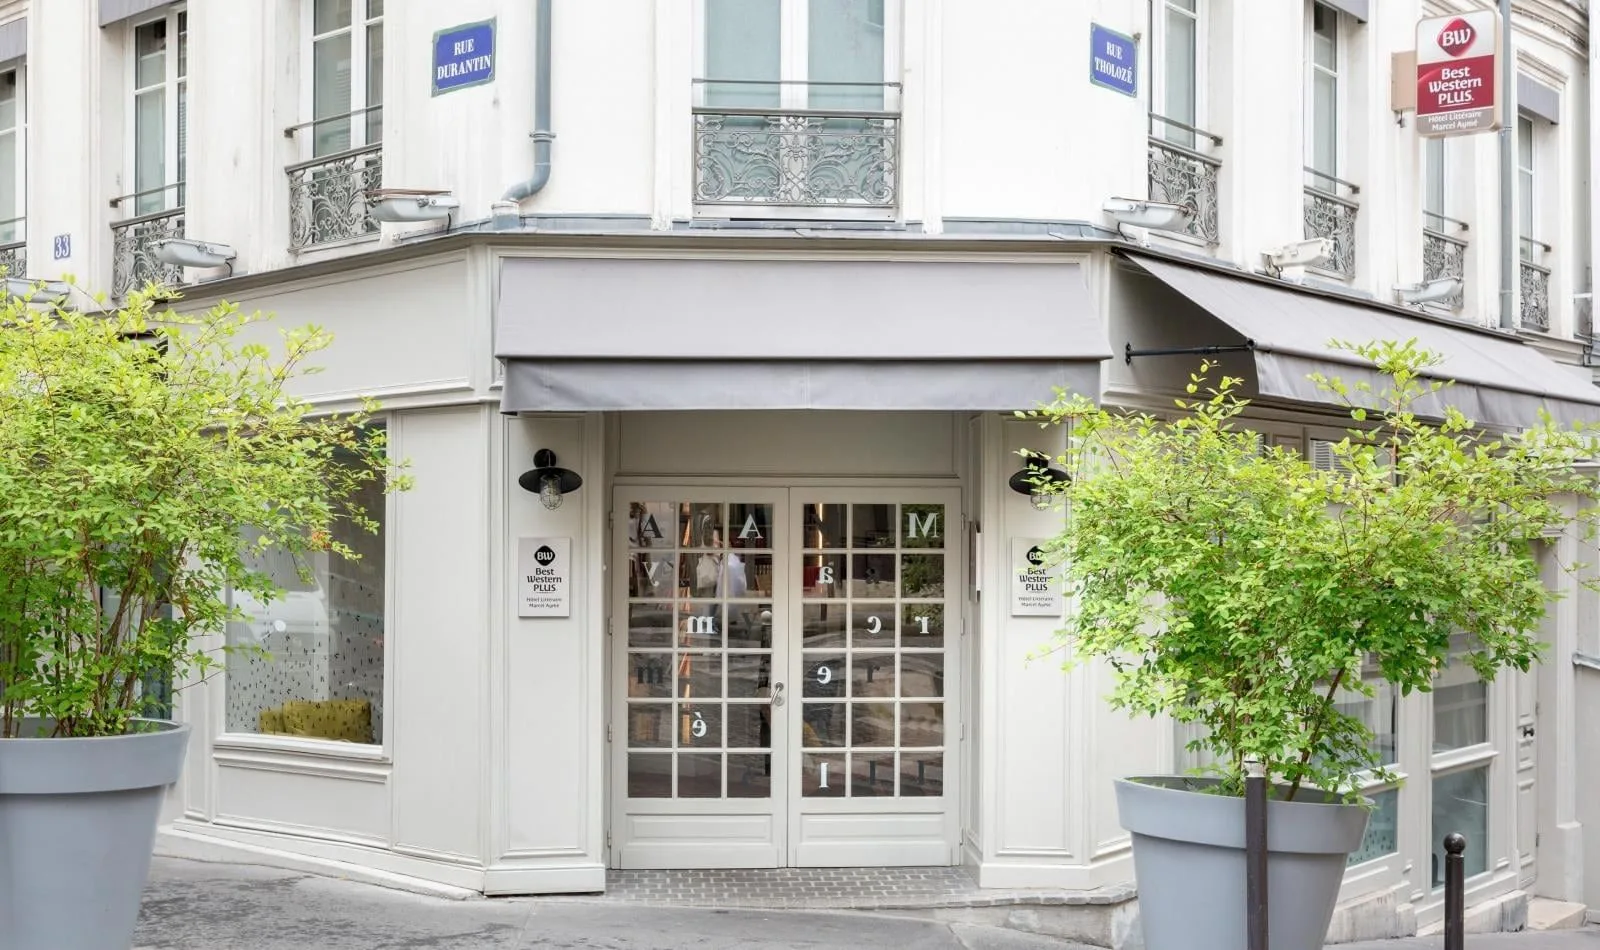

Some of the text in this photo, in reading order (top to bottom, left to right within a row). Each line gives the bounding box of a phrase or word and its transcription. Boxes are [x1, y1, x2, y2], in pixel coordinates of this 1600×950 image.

[1442, 28, 1471, 47] BW
[454, 38, 474, 56] RUE
[1106, 41, 1123, 60] RUE
[437, 54, 492, 80] DURANTIN
[1094, 56, 1133, 84] THOLOZÉ
[1441, 66, 1471, 80] Best
[1428, 77, 1482, 93] Western
[1432, 120, 1456, 131] Marcel
[55, 236, 70, 258] 33
[537, 551, 554, 561] BW
[535, 567, 555, 575] Best
[527, 575, 562, 583] Western
[533, 584, 556, 592] PLUS
[1025, 583, 1048, 591] PLUS
